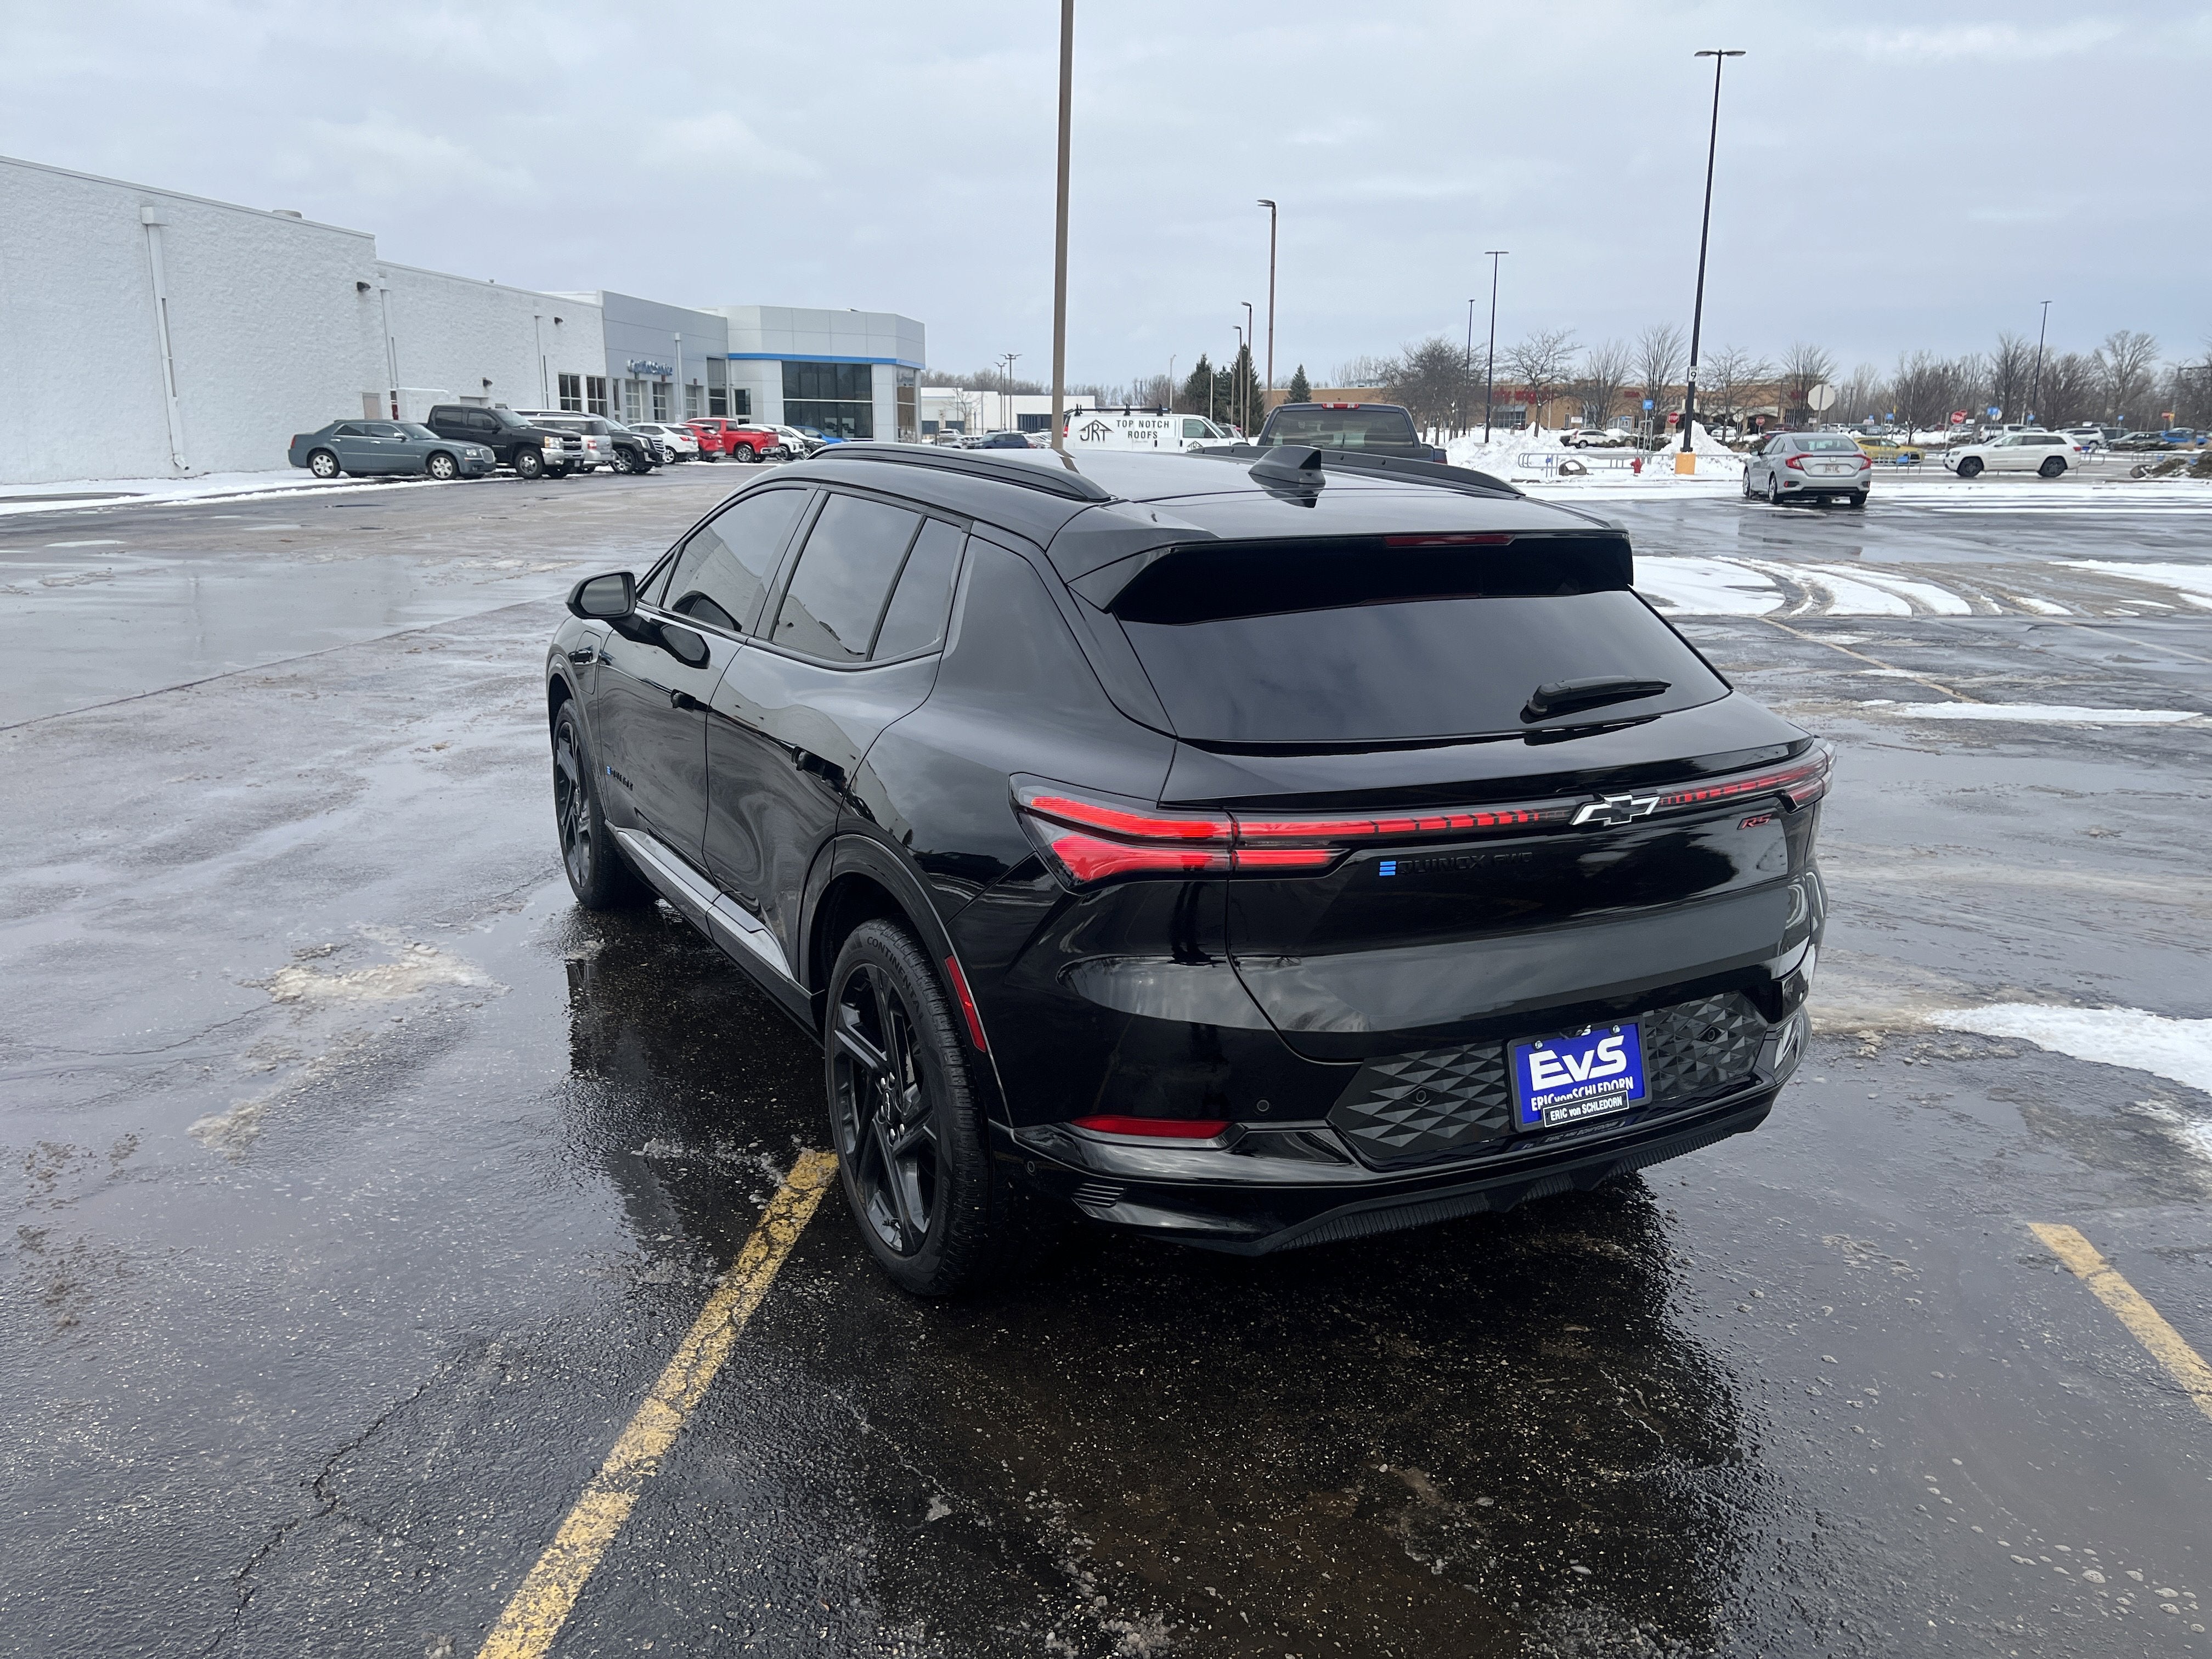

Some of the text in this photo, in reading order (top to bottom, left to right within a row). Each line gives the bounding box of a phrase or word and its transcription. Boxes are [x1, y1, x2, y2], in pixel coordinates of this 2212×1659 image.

[1690, 371, 1696, 381] 9
[1080, 423, 1106, 442] JRT
[1116, 419, 1170, 428] TOP NOTCH
[1127, 431, 1158, 439] ROOFS
[1737, 812, 1773, 830] RS
[867, 936, 924, 1022] CONTINENTAL
[1550, 1096, 1623, 1121] ERIC von SCHLEDORN
